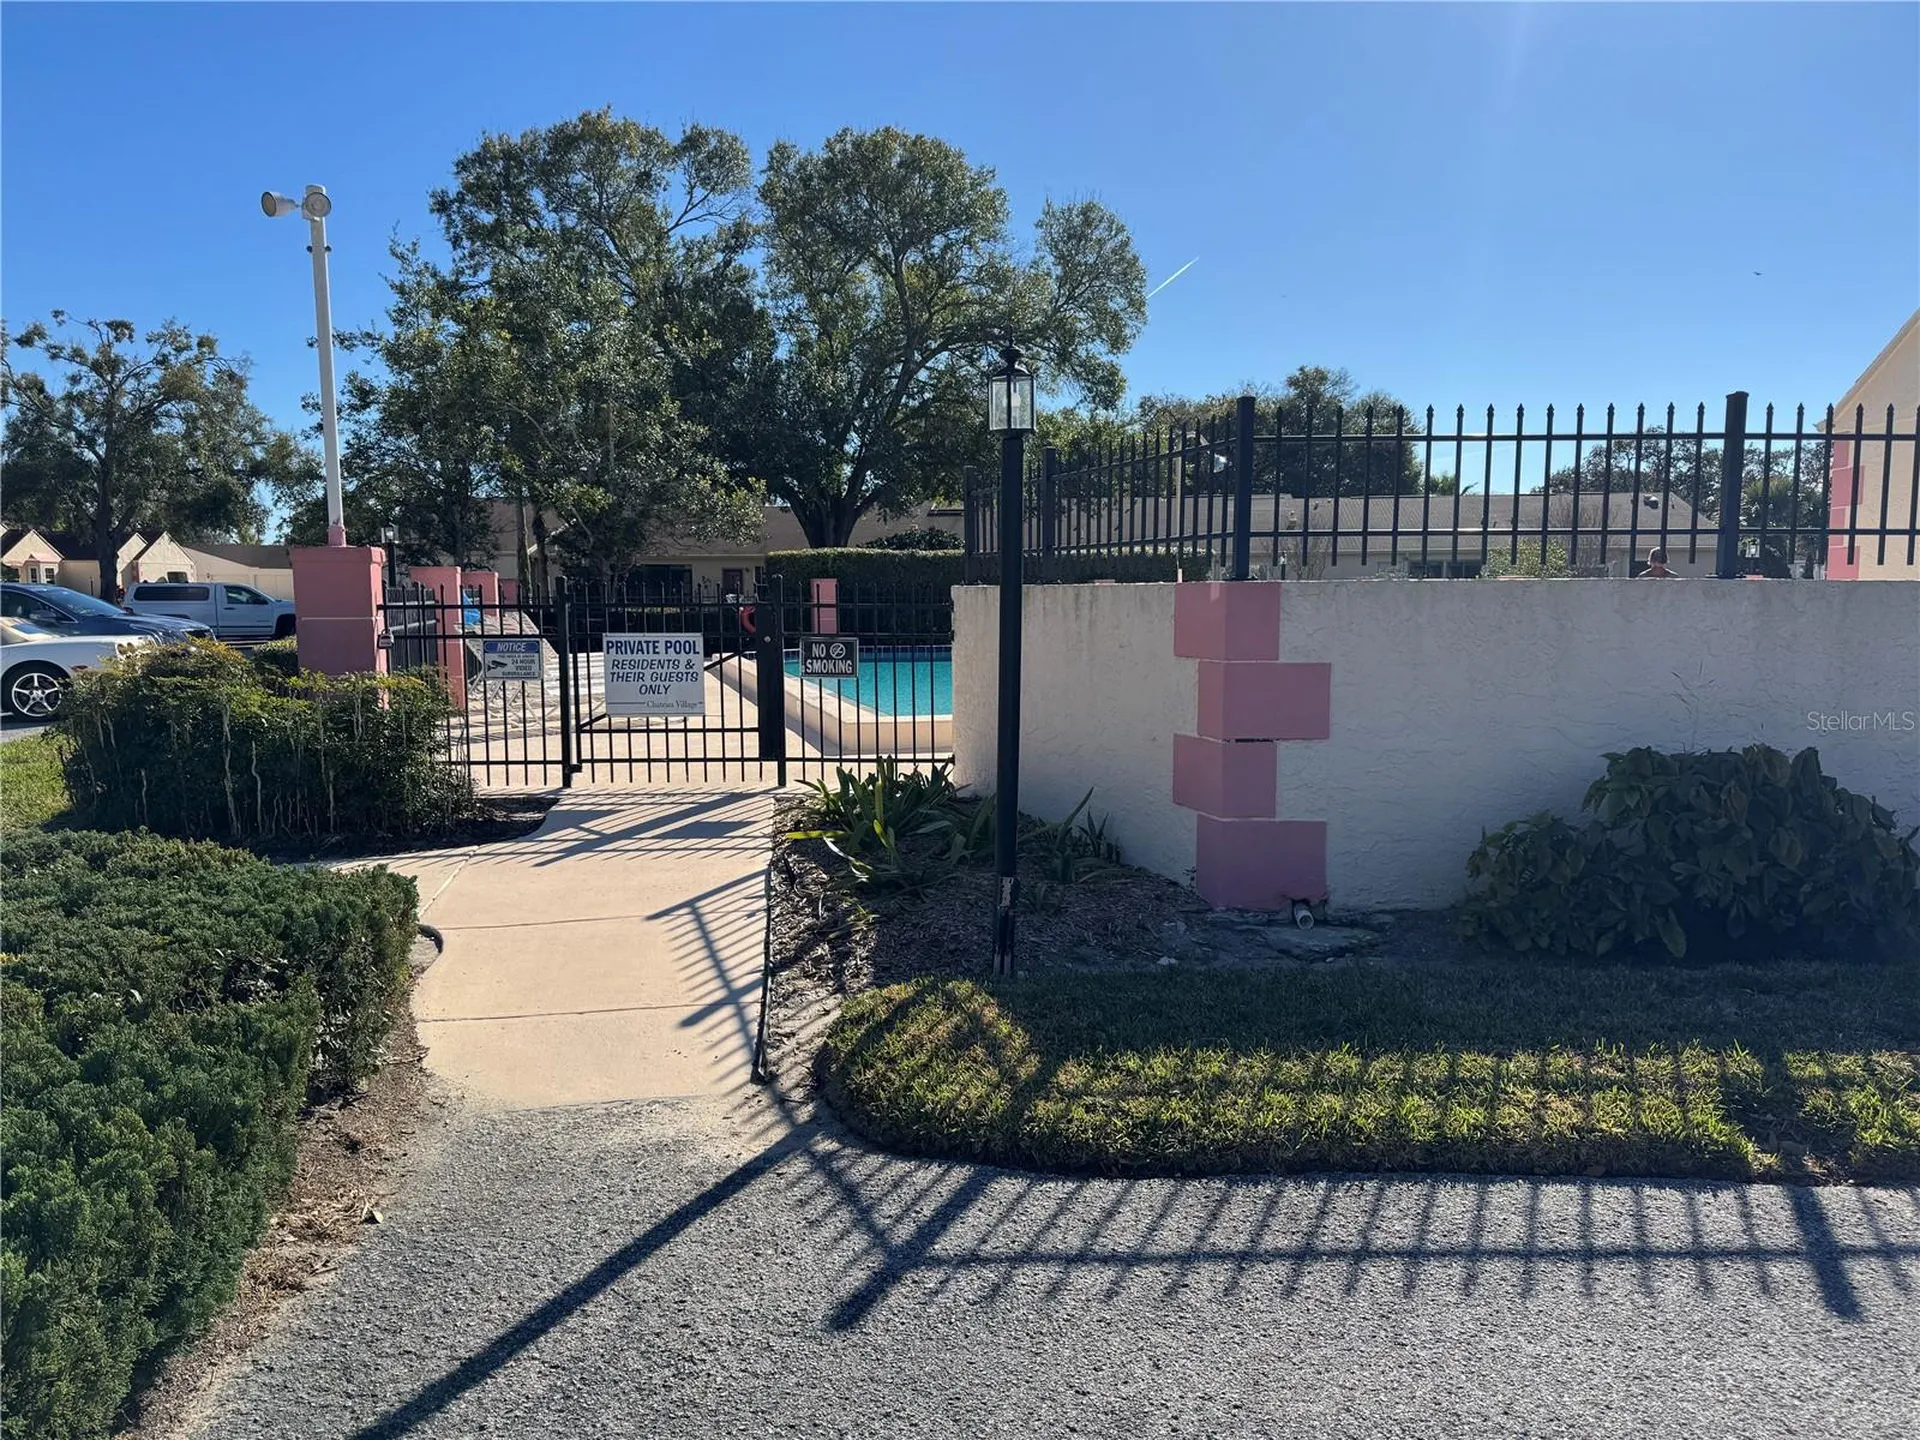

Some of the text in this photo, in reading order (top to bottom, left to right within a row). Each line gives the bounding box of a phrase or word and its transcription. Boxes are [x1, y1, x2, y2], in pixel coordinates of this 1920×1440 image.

[496, 642, 527, 652] NOTICE
[606, 640, 700, 655] PRIVATE POOL
[811, 643, 826, 658] NO
[611, 658, 695, 670] RESIDENTS &
[806, 659, 853, 674] SMOKING
[610, 671, 699, 682] THEIR GUESTS
[638, 684, 671, 695] ONLY
